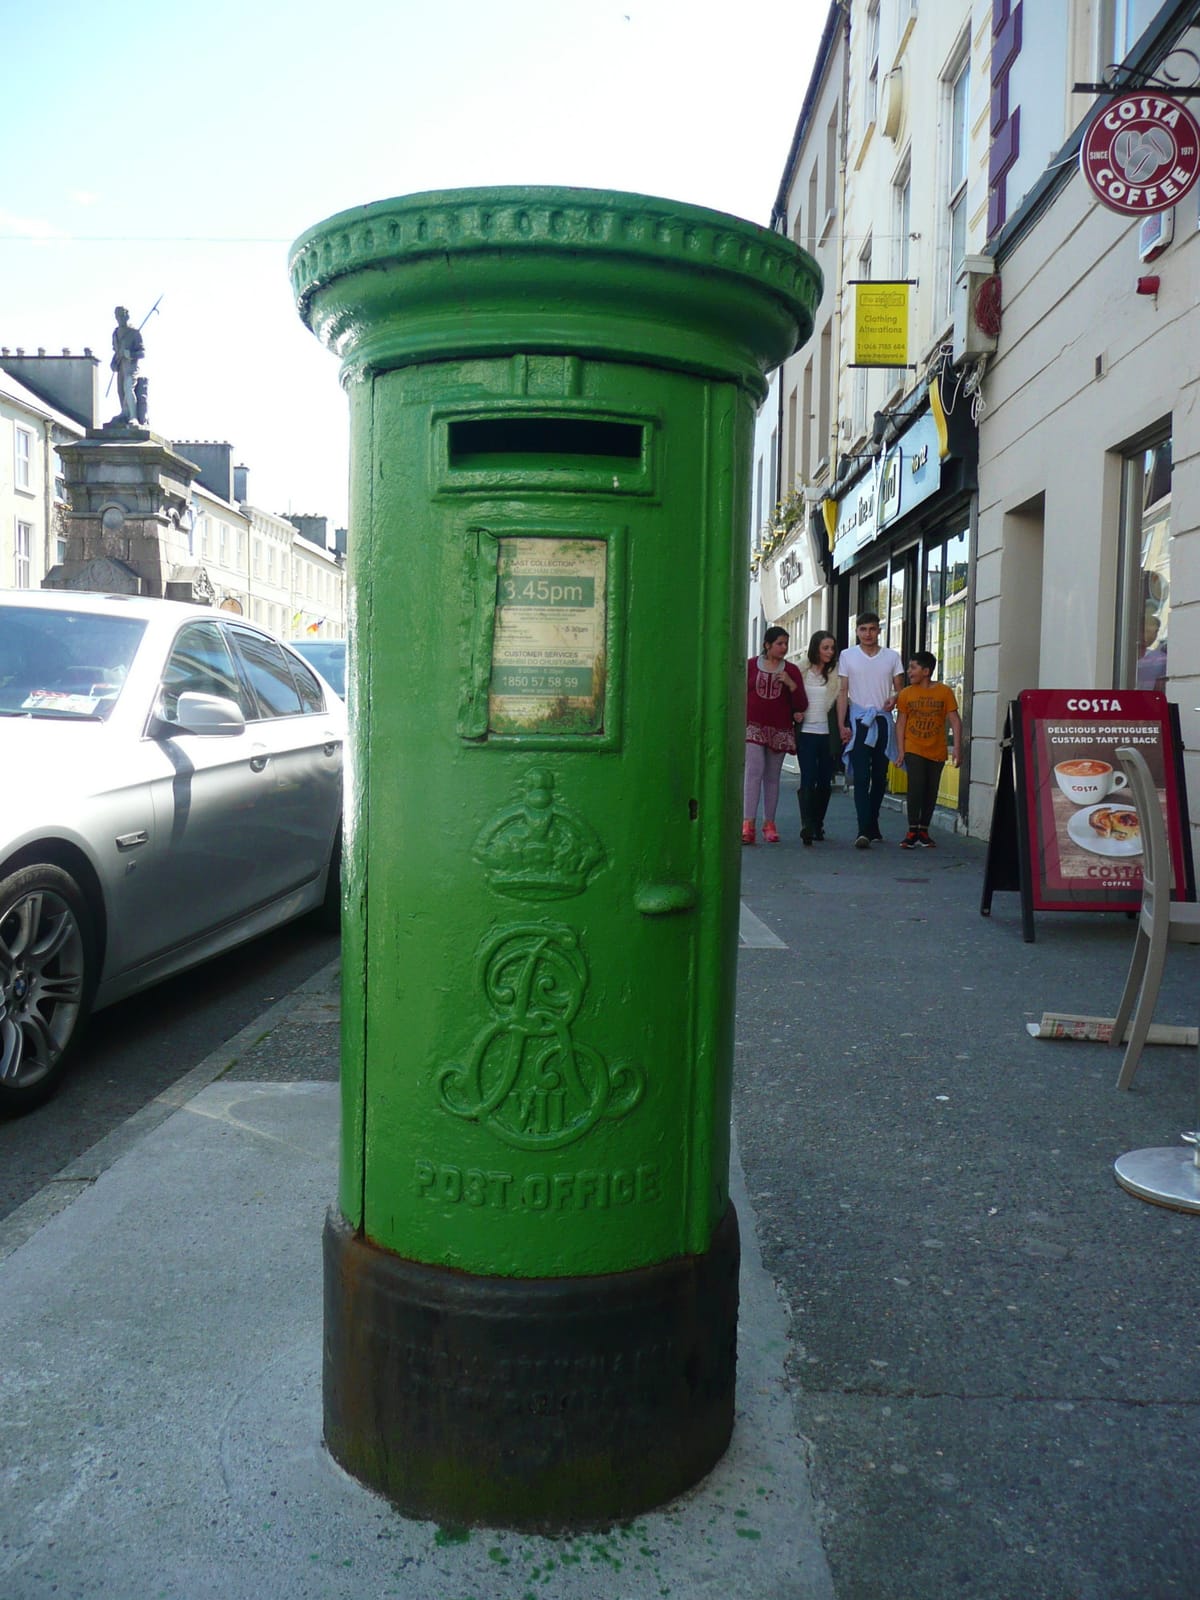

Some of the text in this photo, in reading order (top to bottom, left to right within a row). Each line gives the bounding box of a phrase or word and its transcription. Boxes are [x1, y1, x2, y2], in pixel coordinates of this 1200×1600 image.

[1104, 99, 1180, 129] COSTA
[1089, 151, 1108, 160] SINCE
[1181, 147, 1194, 156] 1971
[1096, 166, 1190, 206] COFFEE
[864, 315, 898, 325] Clothing
[859, 326, 902, 334] Alterations
[504, 580, 583, 605] 3.45pm
[503, 676, 579, 688] 1850 57 58 59
[1066, 699, 1122, 713] COSTA
[1047, 726, 1160, 734] DELICIOUS PORTUGUESE
[1051, 736, 1158, 744] CUSTARD TART IS BACK
[1072, 785, 1098, 793] COSTA
[1087, 864, 1144, 880] COSTA
[508, 1088, 568, 1134] VII
[415, 1159, 664, 1212] POST OFFICE
